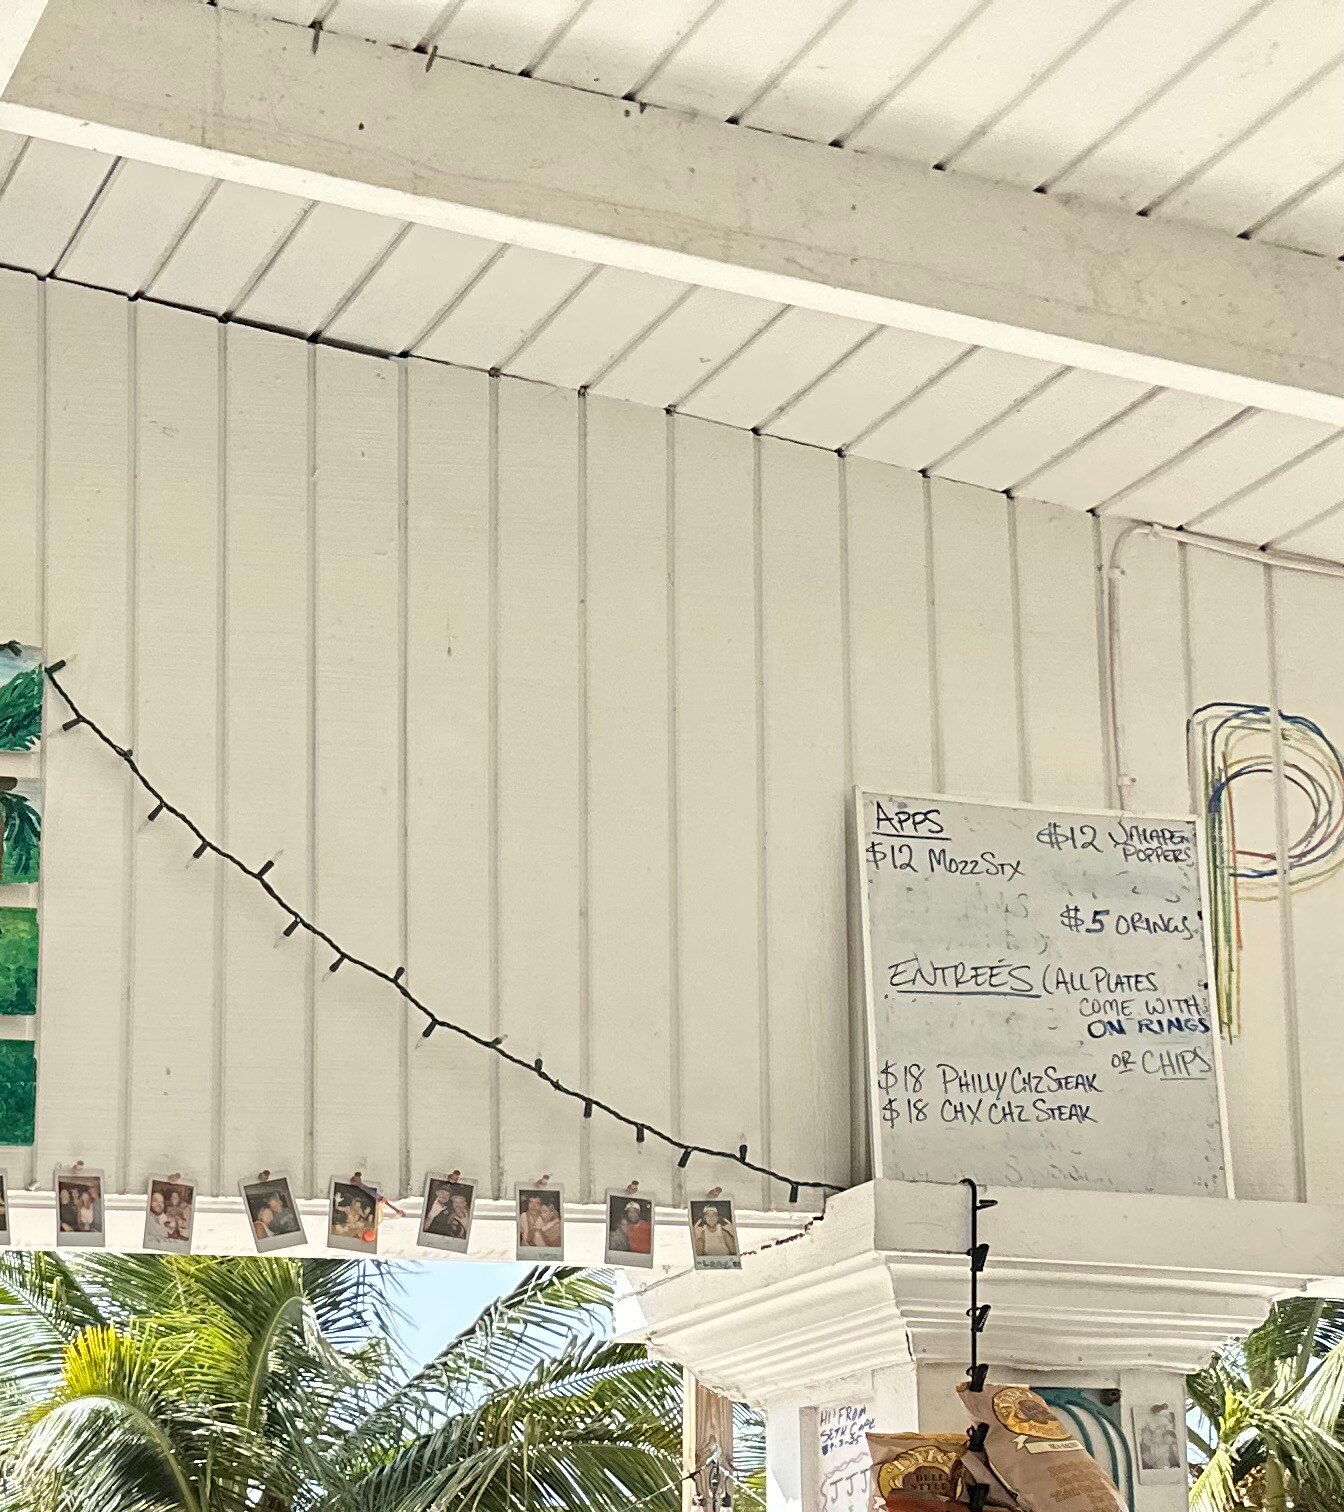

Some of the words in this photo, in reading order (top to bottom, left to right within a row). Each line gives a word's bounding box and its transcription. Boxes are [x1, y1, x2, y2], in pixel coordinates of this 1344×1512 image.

[876, 802, 944, 834] APPS
[1037, 822, 1104, 852] $12
[866, 842, 918, 873] $12
[928, 848, 981, 874] MOZZ
[981, 851, 1025, 881] STX
[1123, 846, 1192, 863] POPPERS
[1060, 904, 1110, 934] $5
[1095, 967, 1158, 992] PLATES
[1080, 998, 1131, 1017] COME
[1144, 994, 1200, 1018] WITH
[1087, 1020, 1125, 1038] ON
[1138, 1018, 1210, 1034] RINGS
[1112, 1051, 1136, 1068] OR
[1141, 1051, 1212, 1075] CHIPS
[877, 1062, 923, 1096] $18
[937, 1064, 1007, 1100] PHILLY
[1011, 1067, 1044, 1094] CHZ
[1045, 1066, 1102, 1093] STEAK
[882, 1099, 929, 1128] $18
[941, 1099, 983, 1124] CHX
[988, 1100, 1029, 1125] CHZ
[1033, 1100, 1098, 1123] STEAK
